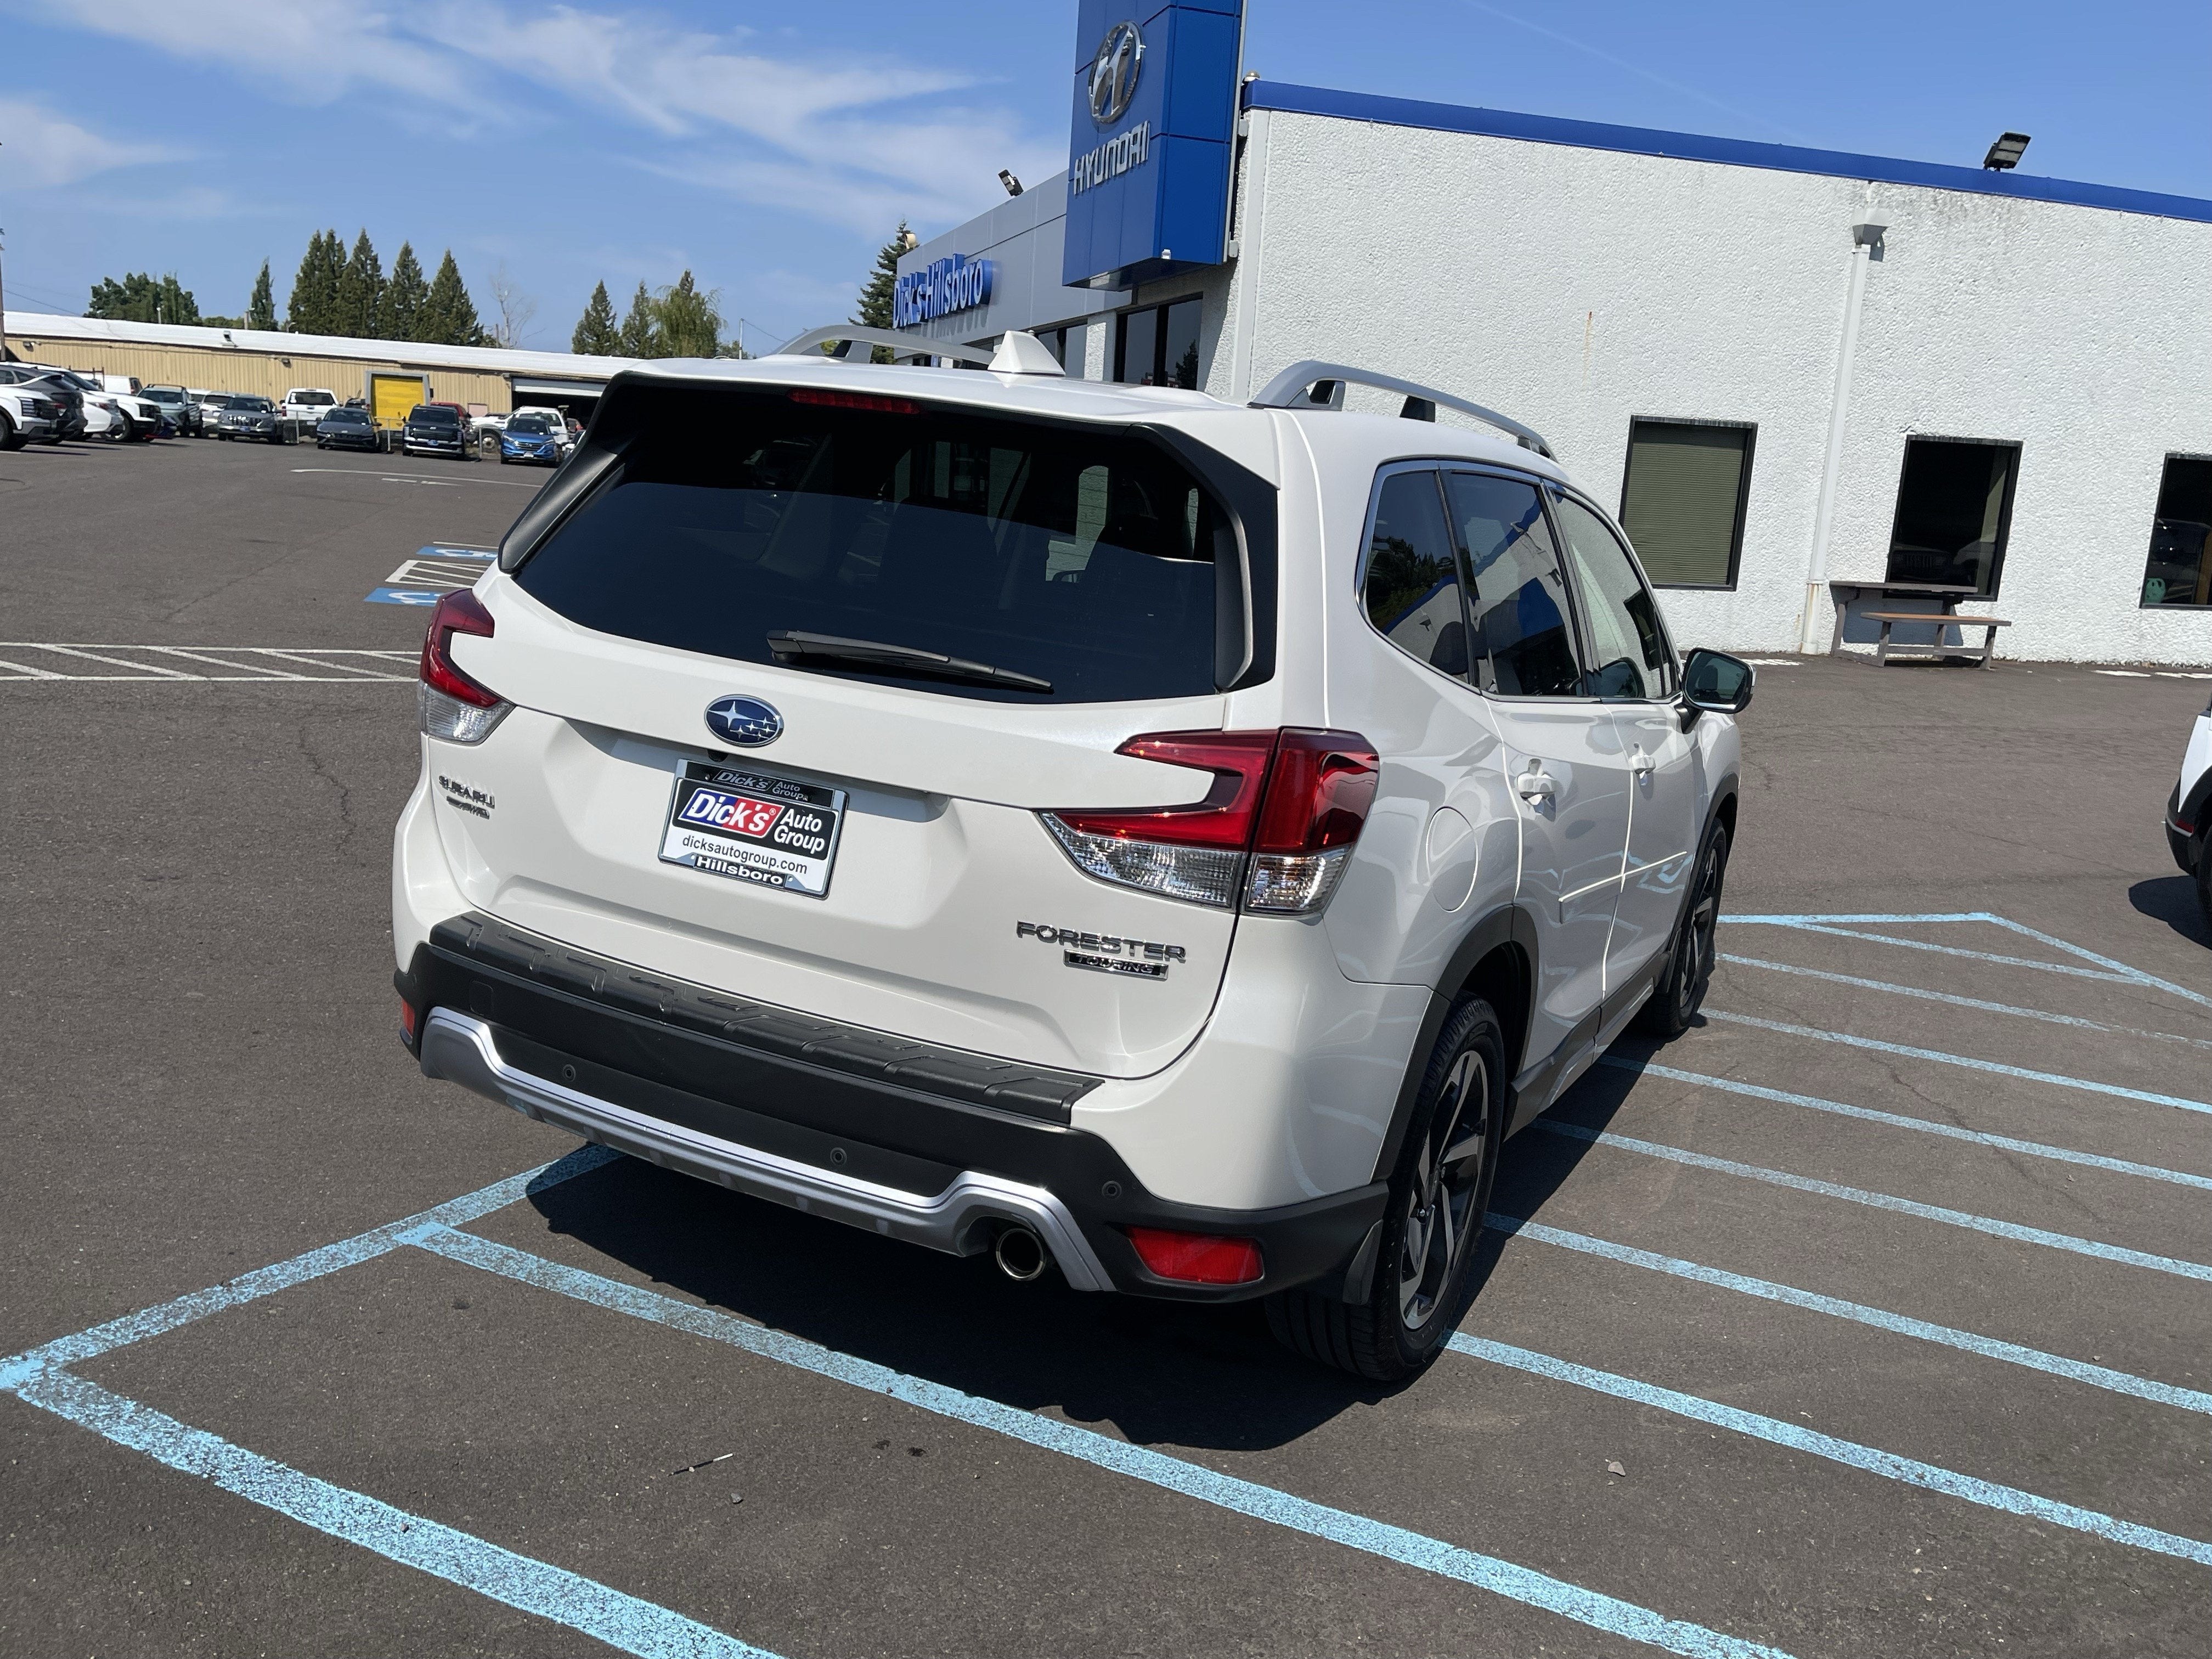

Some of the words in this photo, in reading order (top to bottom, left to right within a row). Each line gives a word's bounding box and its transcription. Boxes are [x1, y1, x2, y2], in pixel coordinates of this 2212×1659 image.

[1074, 120, 1150, 196] HYUNDAI
[925, 253, 989, 319] Hillsboro
[717, 771, 768, 789] Dick's
[776, 781, 800, 792] Auto
[772, 787, 804, 800] Group
[686, 793, 770, 832] Dick's
[780, 809, 822, 833] Auto
[682, 834, 808, 875] dicksautogroup.com
[774, 825, 825, 854] Group
[696, 854, 783, 886] Hillsboro
[1016, 919, 1187, 964] FORESTER
